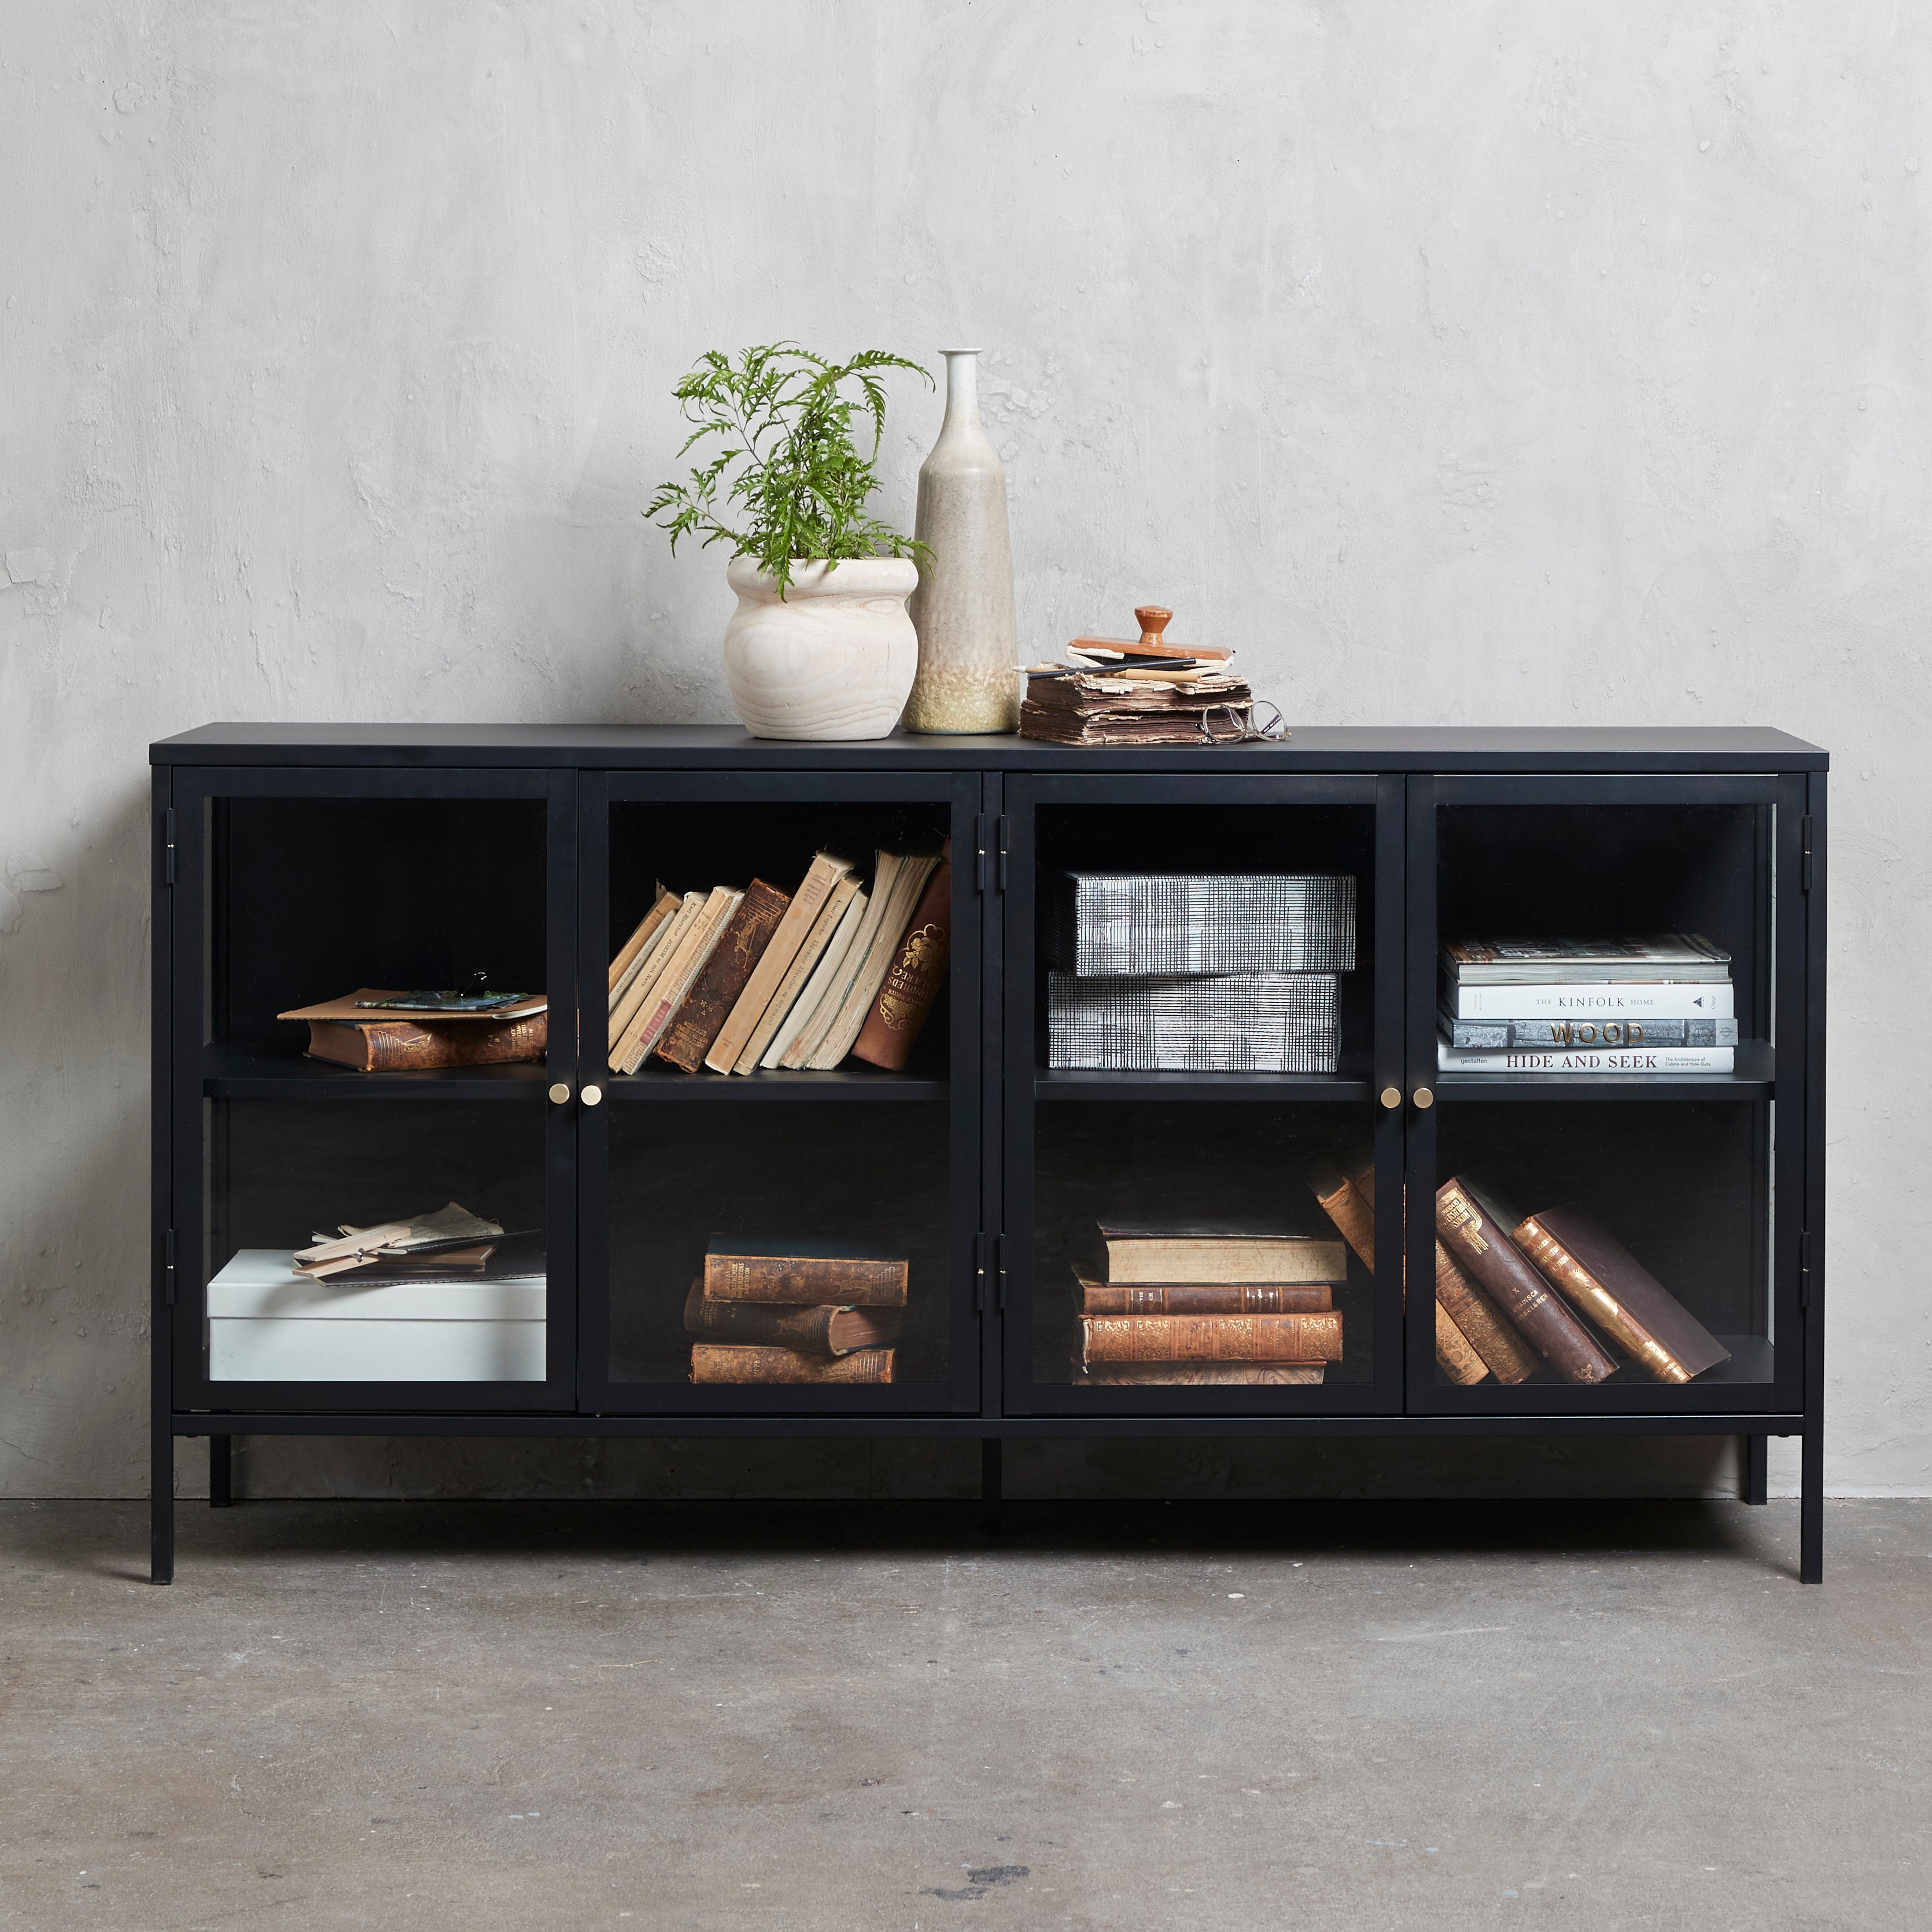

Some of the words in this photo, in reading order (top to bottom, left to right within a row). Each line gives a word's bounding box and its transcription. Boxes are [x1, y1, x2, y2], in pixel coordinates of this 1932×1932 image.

[685, 901, 697, 915] Karl
[829, 898, 842, 914] Albert
[648, 963, 658, 975] mit
[640, 972, 652, 989] Navn
[1559, 997, 1625, 1007] KINFOLK
[1550, 1022, 1645, 1043] WOOD
[1461, 1057, 1488, 1065] gestalten
[1506, 1055, 1553, 1069] HIDE
[1561, 1055, 1601, 1069] AND
[1608, 1055, 1658, 1069] SEEK
[1511, 1286, 1520, 1295] X
